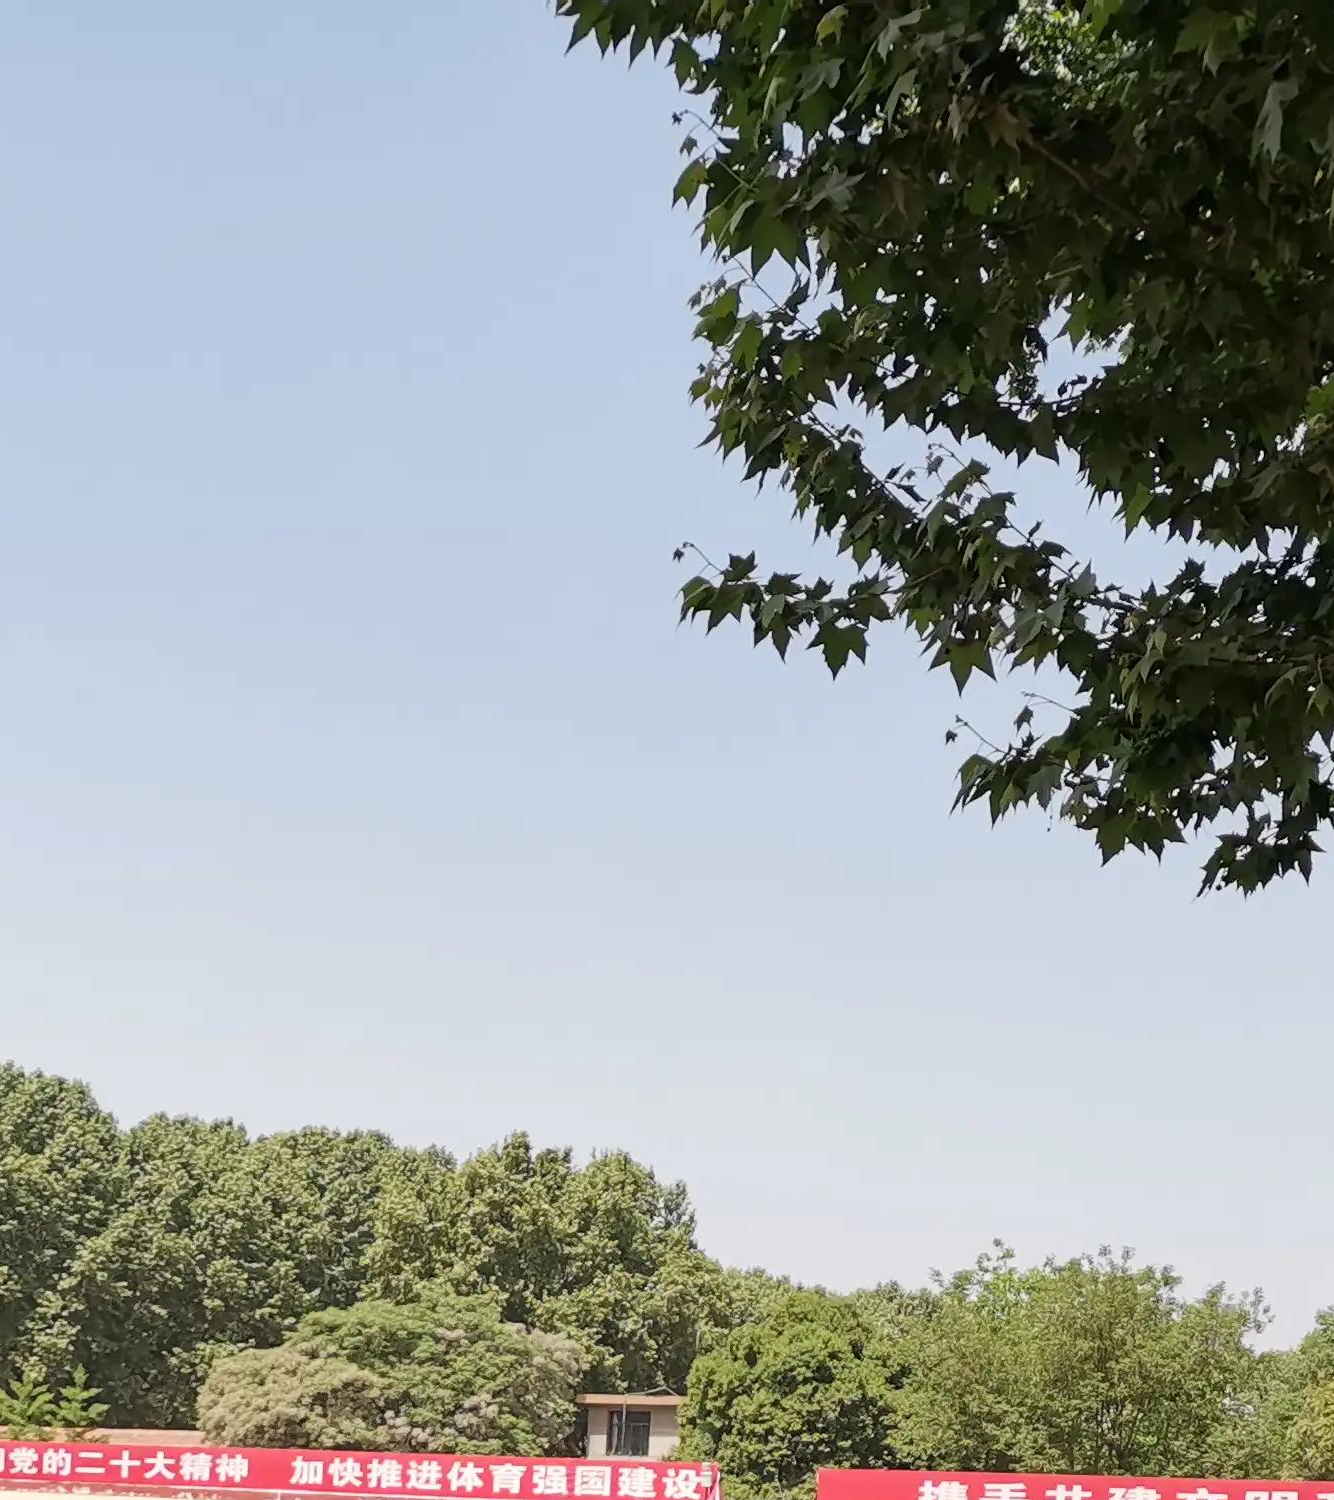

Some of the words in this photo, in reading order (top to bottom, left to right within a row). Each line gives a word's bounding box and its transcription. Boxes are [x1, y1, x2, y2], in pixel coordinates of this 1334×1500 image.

[289, 1455, 702, 1500] 加快推进体育强国建设
